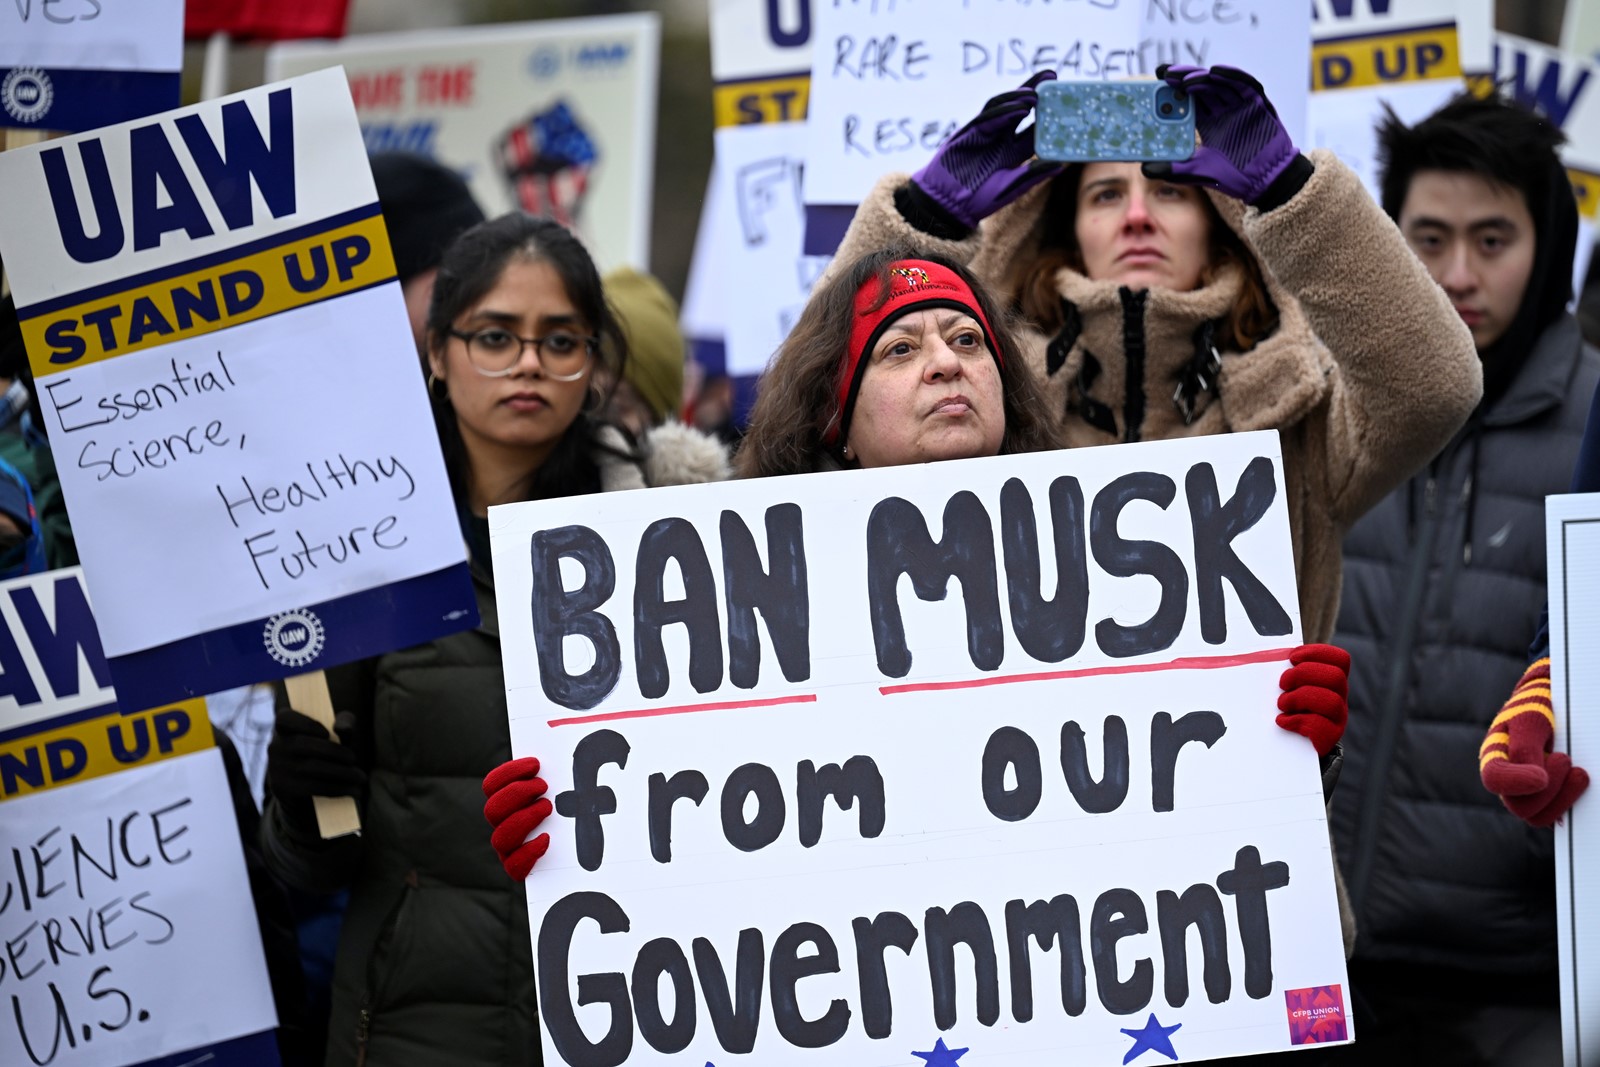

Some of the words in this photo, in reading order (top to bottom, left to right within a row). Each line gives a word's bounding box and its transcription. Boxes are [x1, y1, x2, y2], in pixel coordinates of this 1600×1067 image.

[833, 34, 931, 80] RARE
[1373, 41, 1444, 81] UP
[40, 87, 297, 264] UAW
[44, 269, 265, 364] STAND
[283, 234, 371, 294] UP
[45, 351, 236, 433] Essential
[77, 420, 247, 481] Science,
[216, 454, 415, 527] Healthy
[244, 515, 407, 590] Future
[531, 502, 811, 710] BAN
[866, 456, 1293, 678] MUSK
[280, 627, 306, 646] UAW
[107, 709, 191, 763] UP
[555, 729, 886, 872] from
[982, 710, 1227, 822] our
[0, 799, 192, 915] IENCE
[0, 891, 174, 984] ERVES
[537, 845, 1290, 1067] Government
[11, 965, 150, 1067] U.S.
[1292, 1009, 1312, 1018] CFPB
[1313, 1006, 1340, 1016] UNION
